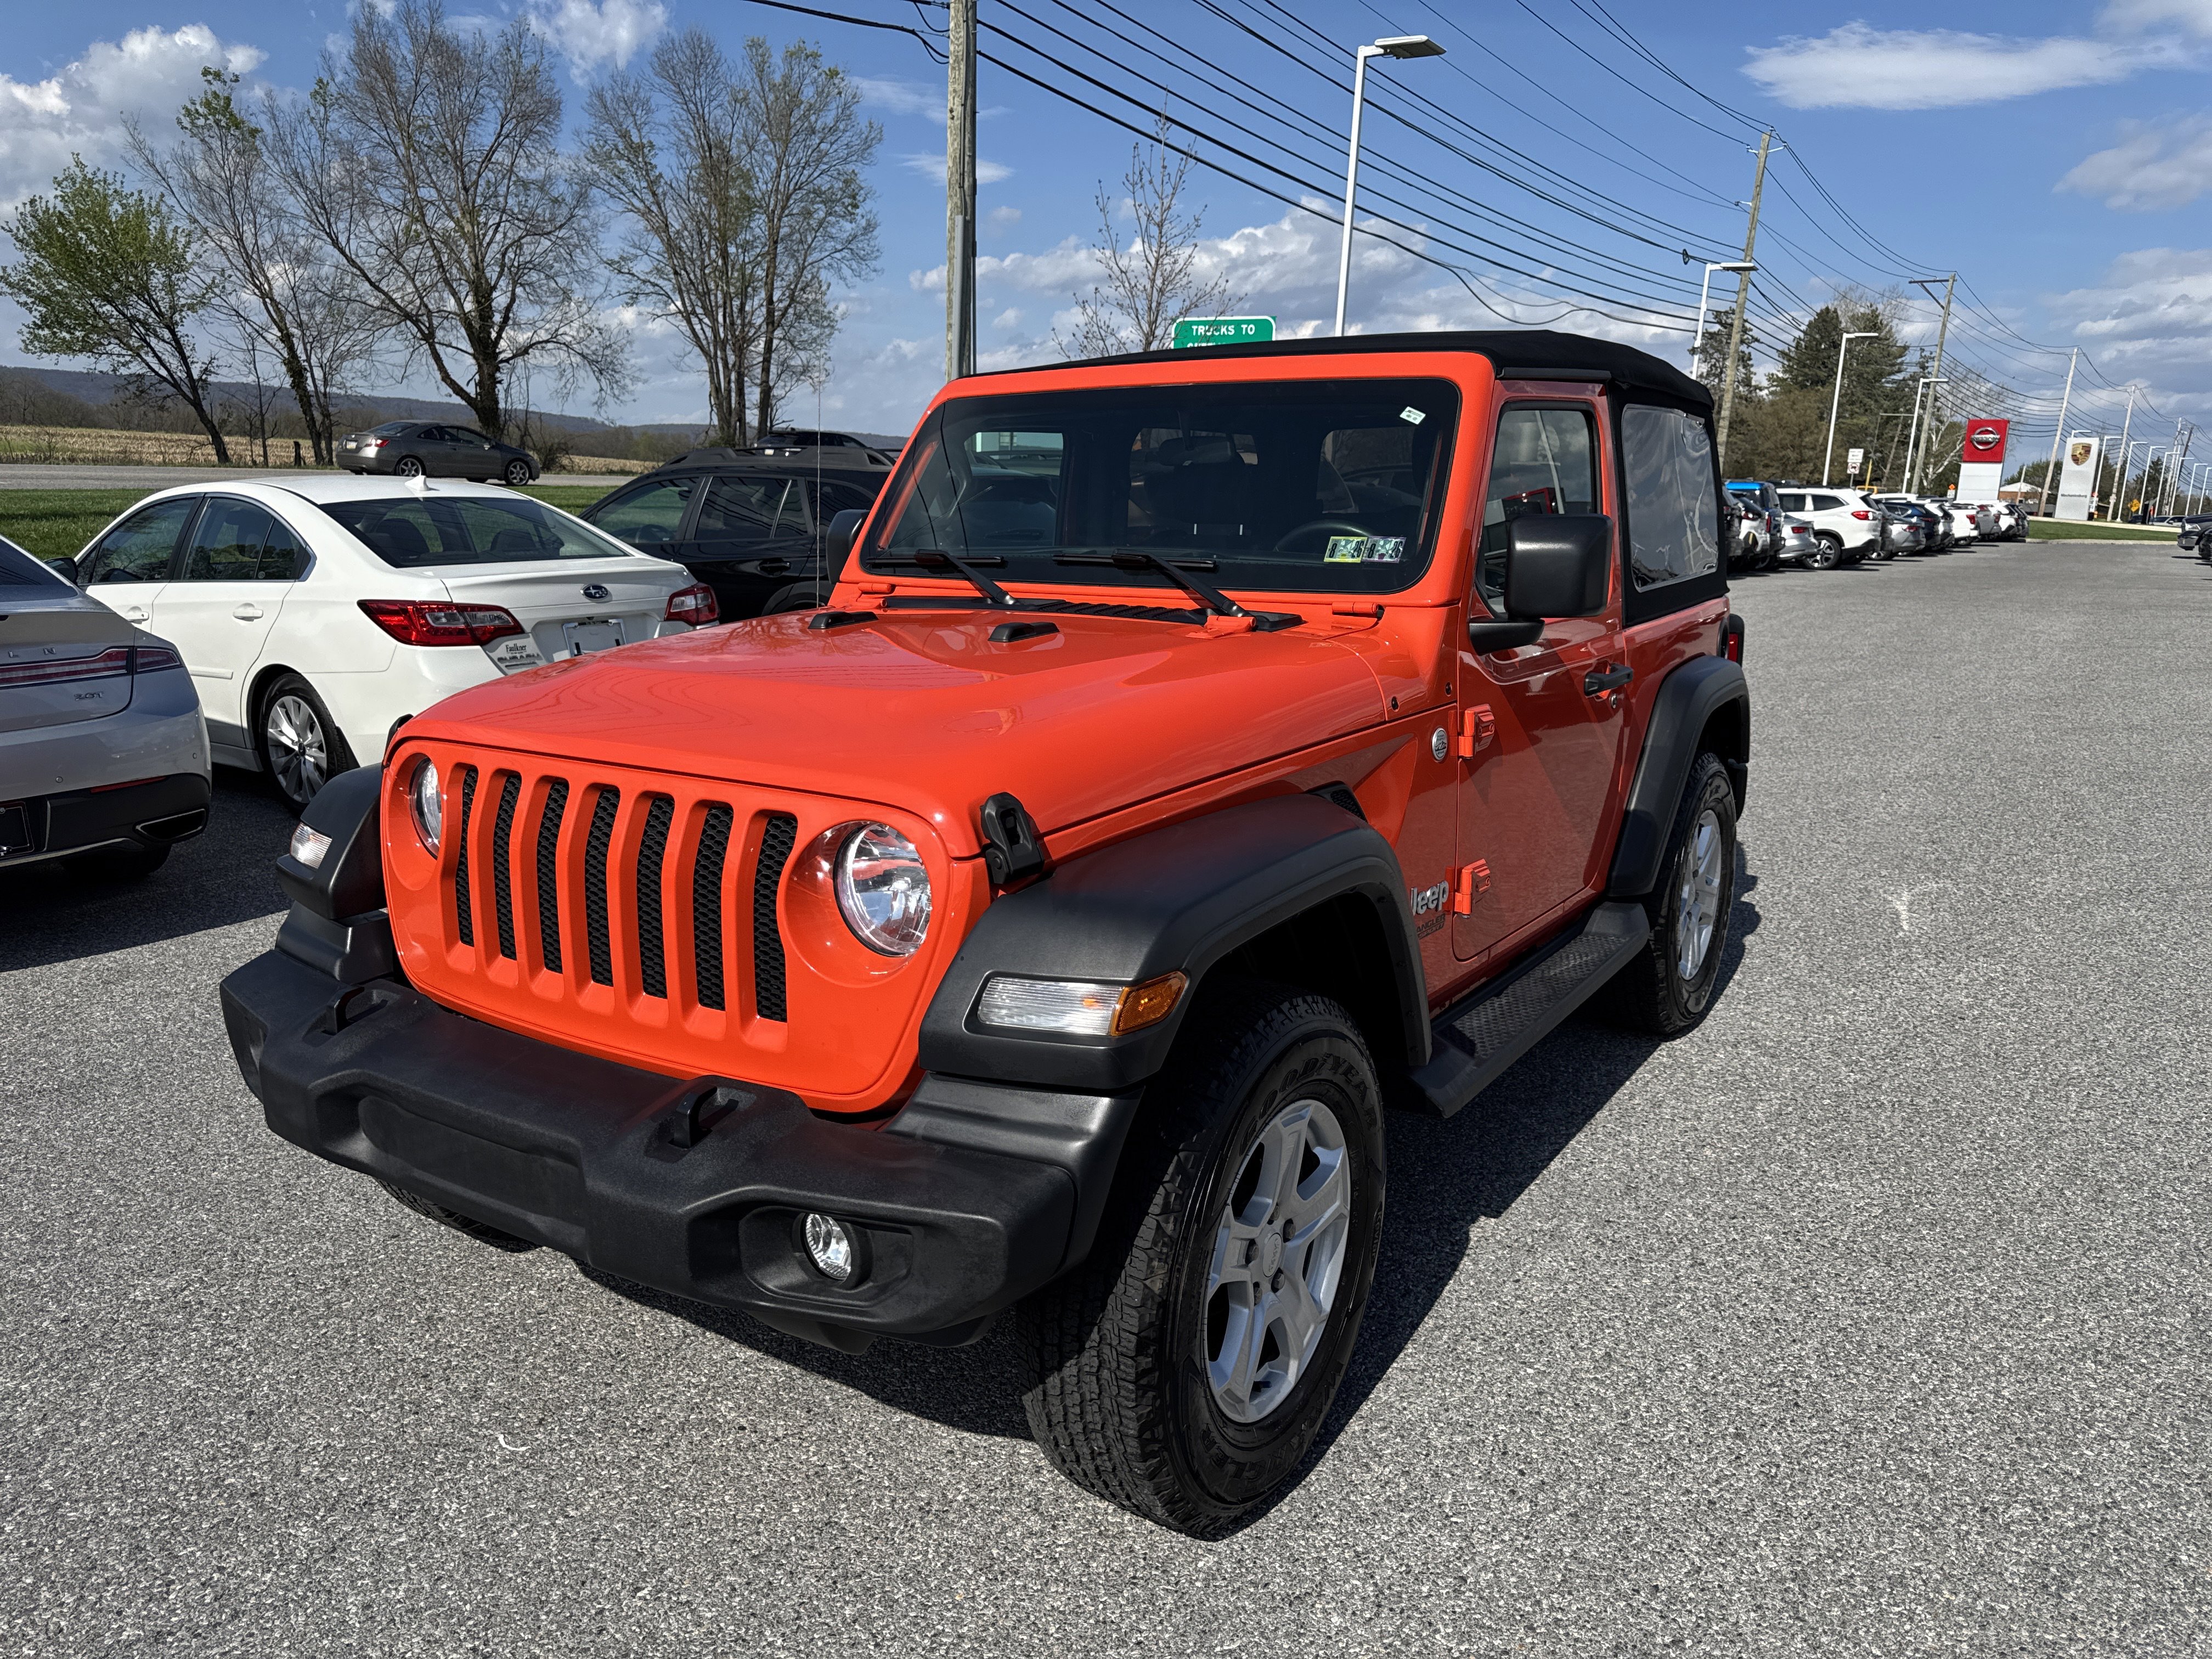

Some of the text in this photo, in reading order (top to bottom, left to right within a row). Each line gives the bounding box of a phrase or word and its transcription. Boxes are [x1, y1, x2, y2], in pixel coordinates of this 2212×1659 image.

[1192, 324, 1255, 336] TRUCKS TO
[1329, 540, 1364, 558] 8 26
[1368, 540, 1403, 558] 8 26
[505, 643, 527, 652] Faulkner
[1411, 880, 1449, 916] Jeep
[1239, 1053, 1378, 1157] GOODYEAR
